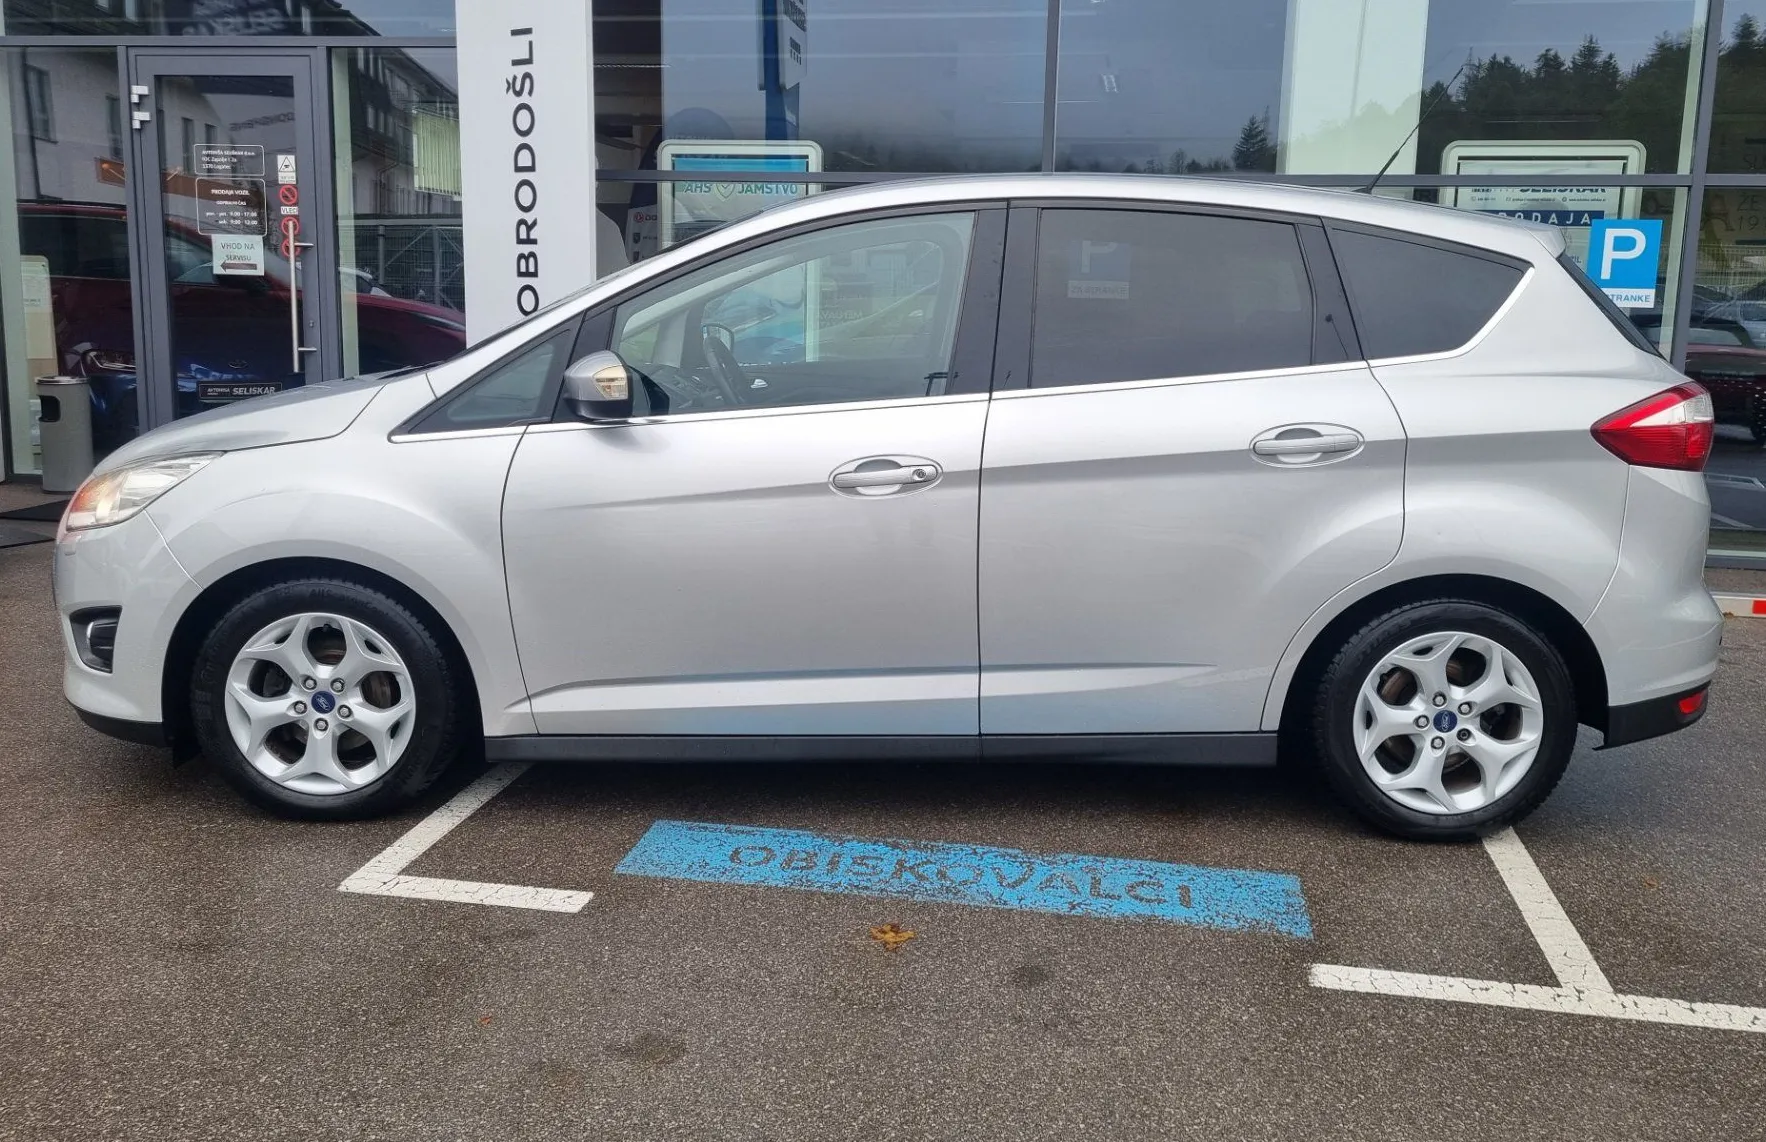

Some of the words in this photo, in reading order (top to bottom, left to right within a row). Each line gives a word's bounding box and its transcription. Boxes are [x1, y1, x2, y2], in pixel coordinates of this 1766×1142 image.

[684, 183, 712, 194] AHS
[738, 183, 798, 195] JAMSTVO
[221, 242, 242, 250] VHOD
[1600, 228, 1646, 279] P
[729, 846, 1192, 908] OBISKOVALCI
